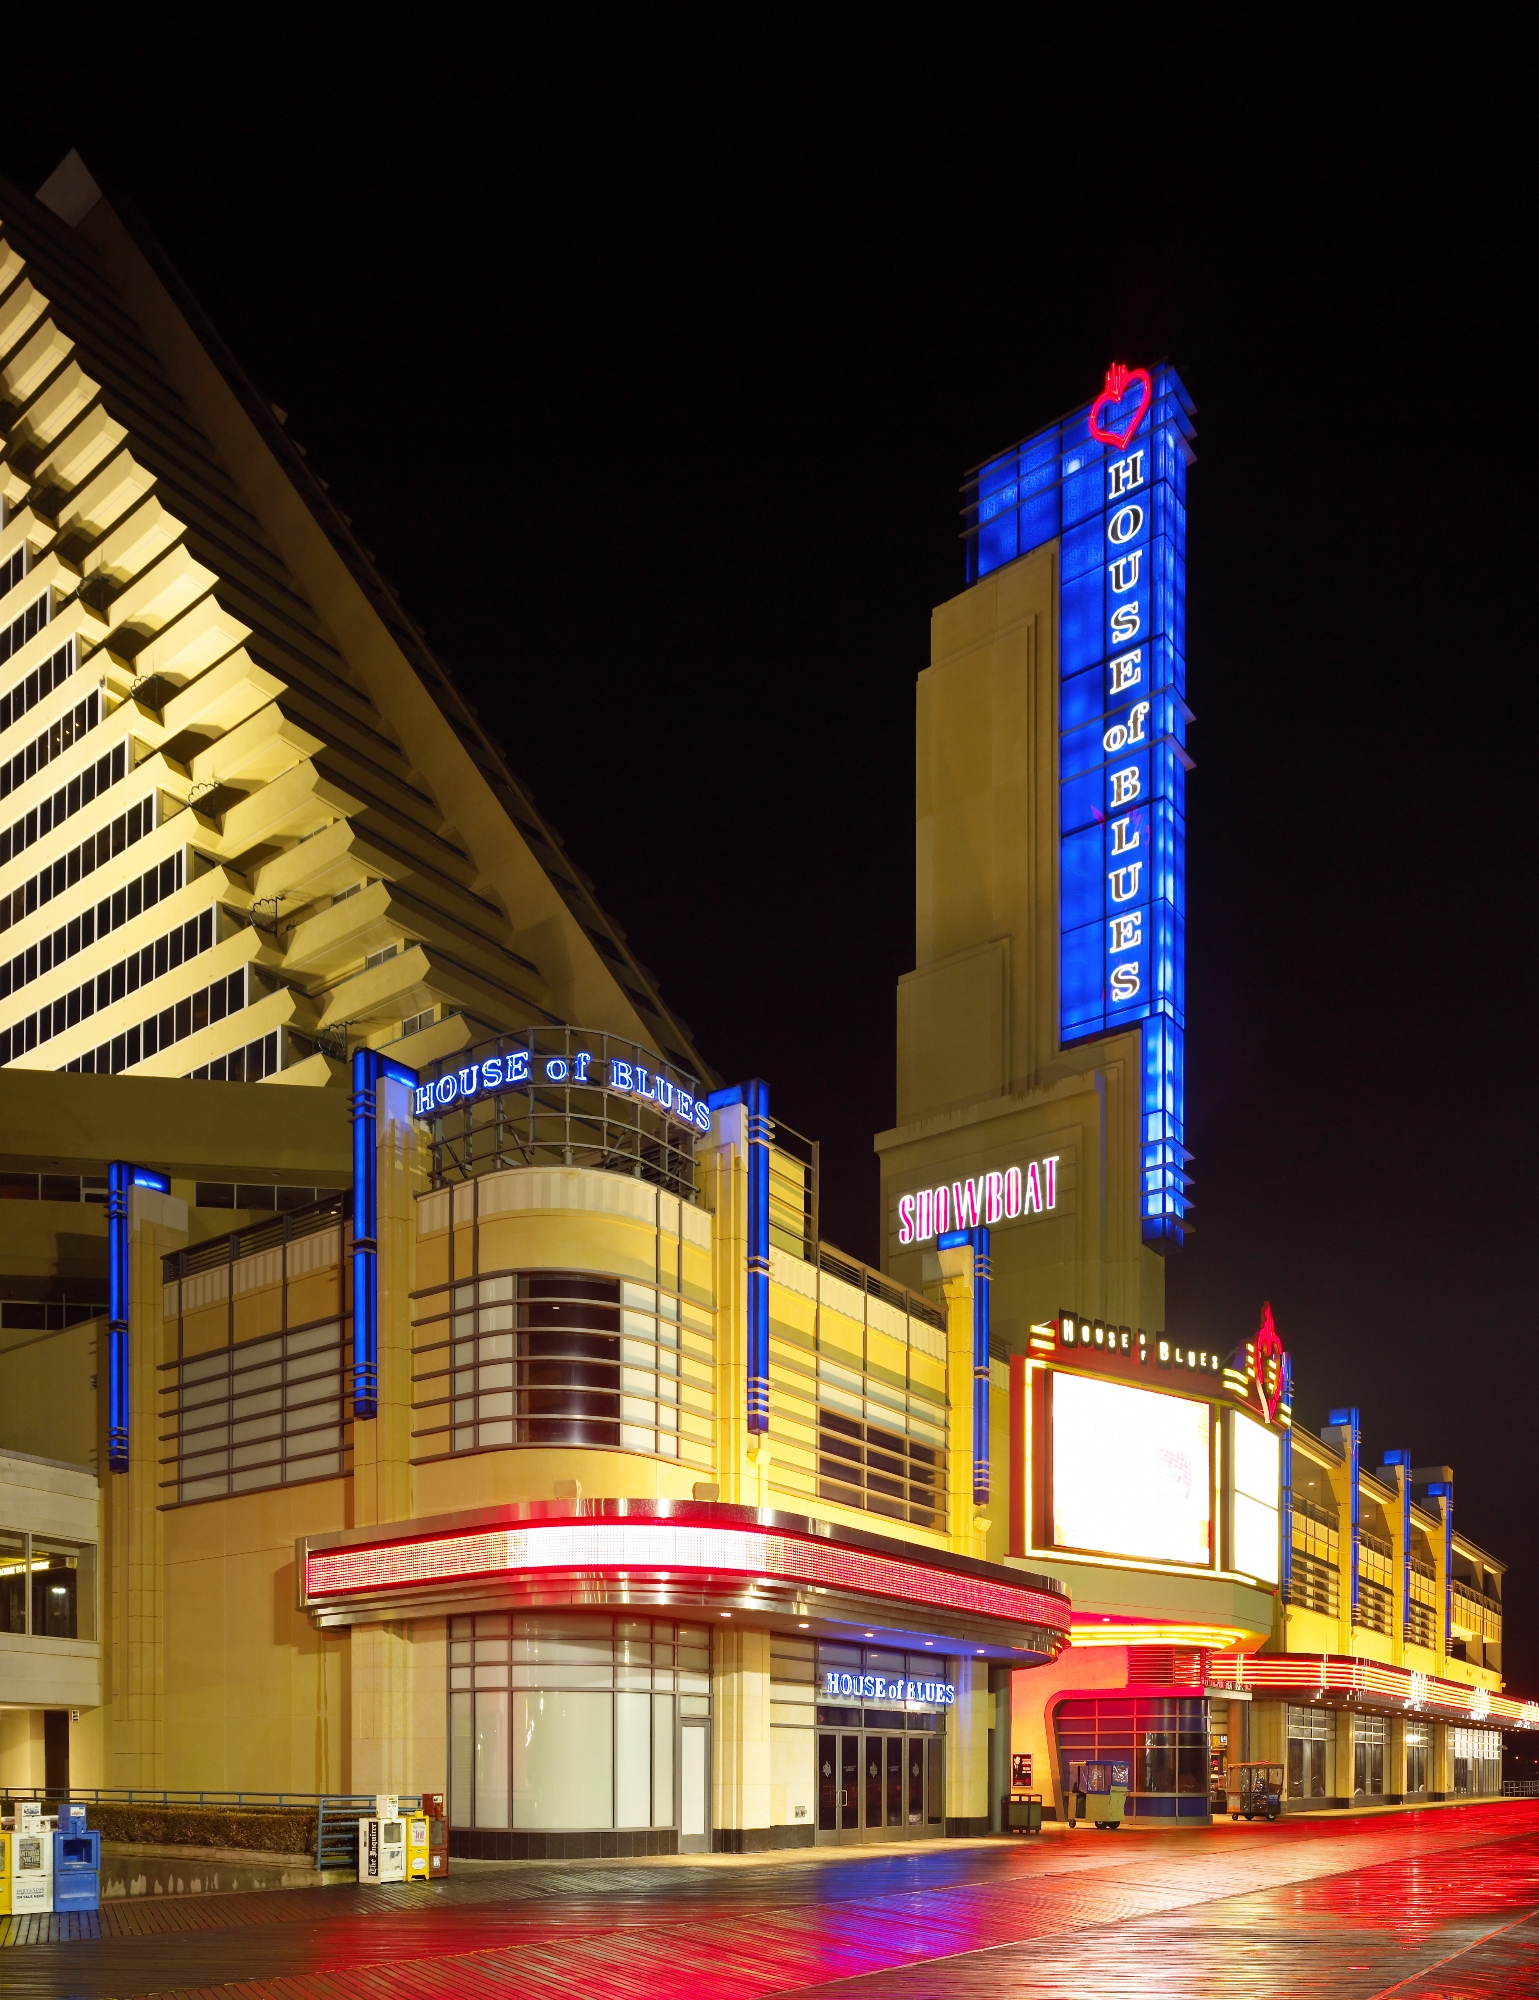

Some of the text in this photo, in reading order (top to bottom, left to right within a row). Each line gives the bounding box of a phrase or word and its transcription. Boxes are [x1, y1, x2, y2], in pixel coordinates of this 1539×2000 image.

[1103, 449, 1149, 1002] HOUSE of BLUES
[414, 1050, 712, 1132] HOUSE of BLUES
[898, 1155, 1060, 1245] SHOWBOAT
[1062, 1317, 1130, 1350] HOUSE
[1158, 1340, 1219, 1371] BLUES
[826, 1672, 955, 1704] HOUSE of BLUES
[369, 1822, 378, 1875] The Inquirer
